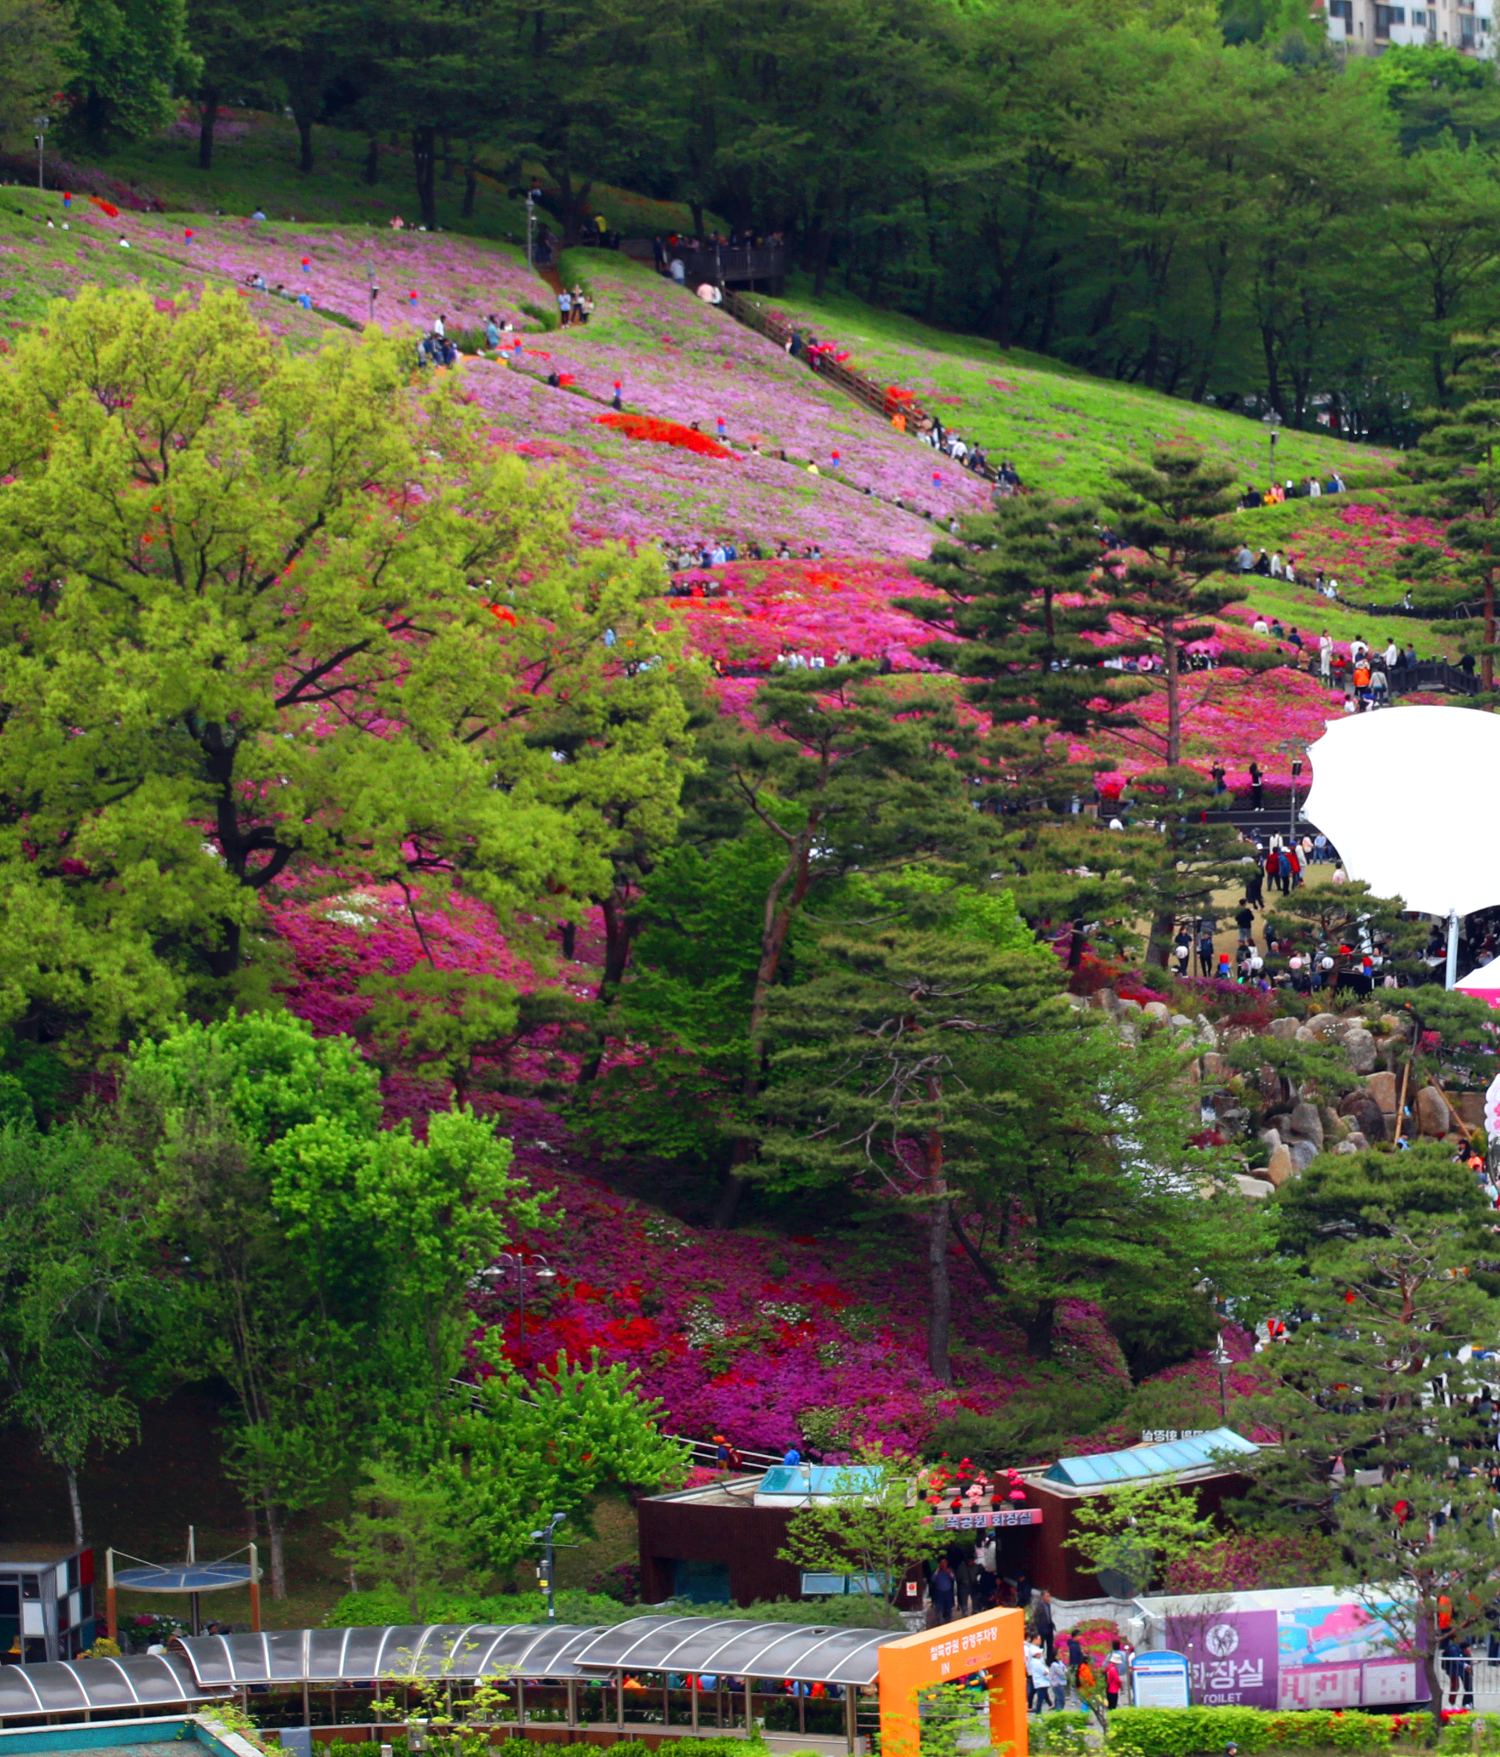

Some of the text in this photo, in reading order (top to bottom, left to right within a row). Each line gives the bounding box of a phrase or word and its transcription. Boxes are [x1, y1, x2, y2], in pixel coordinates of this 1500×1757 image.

[992, 1511, 1032, 1526] 화장실
[930, 1639, 960, 1661] 철쭉공원
[961, 1626, 998, 1650] 공영주차장
[941, 1662, 951, 1675] IN
[1188, 1657, 1264, 1690] 화장실
[1202, 1692, 1243, 1704] TOILET
